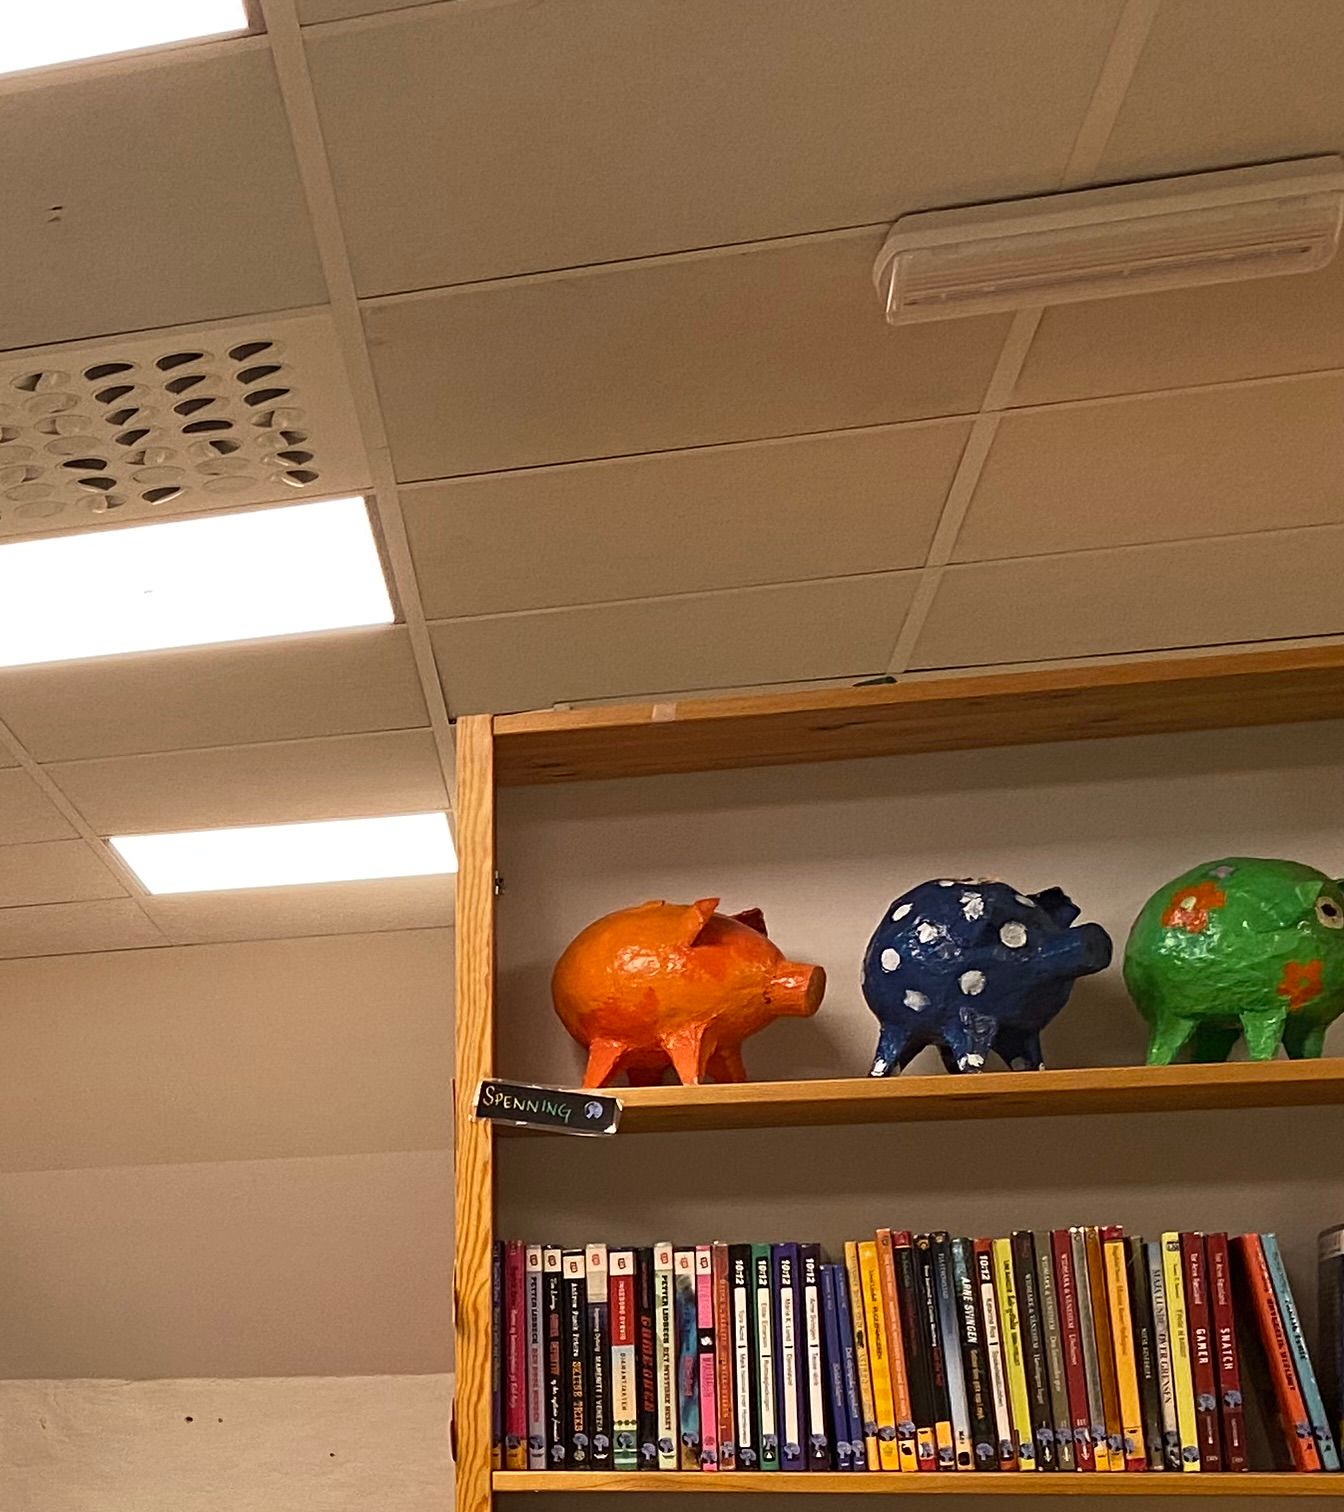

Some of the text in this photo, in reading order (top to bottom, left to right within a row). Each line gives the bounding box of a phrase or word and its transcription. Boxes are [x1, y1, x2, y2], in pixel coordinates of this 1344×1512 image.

[483, 1085, 571, 1123] SPENNING
[735, 1260, 744, 1284] 10:12
[758, 1260, 767, 1285] 10:12
[781, 1260, 791, 1284] 10:12
[806, 1258, 815, 1283] 10:12
[980, 1255, 990, 1280] 10:12
[961, 1277, 977, 1343] ARNE SVINGEN
[1196, 1328, 1208, 1364] GAMER
[1220, 1328, 1232, 1370] SNATCH
